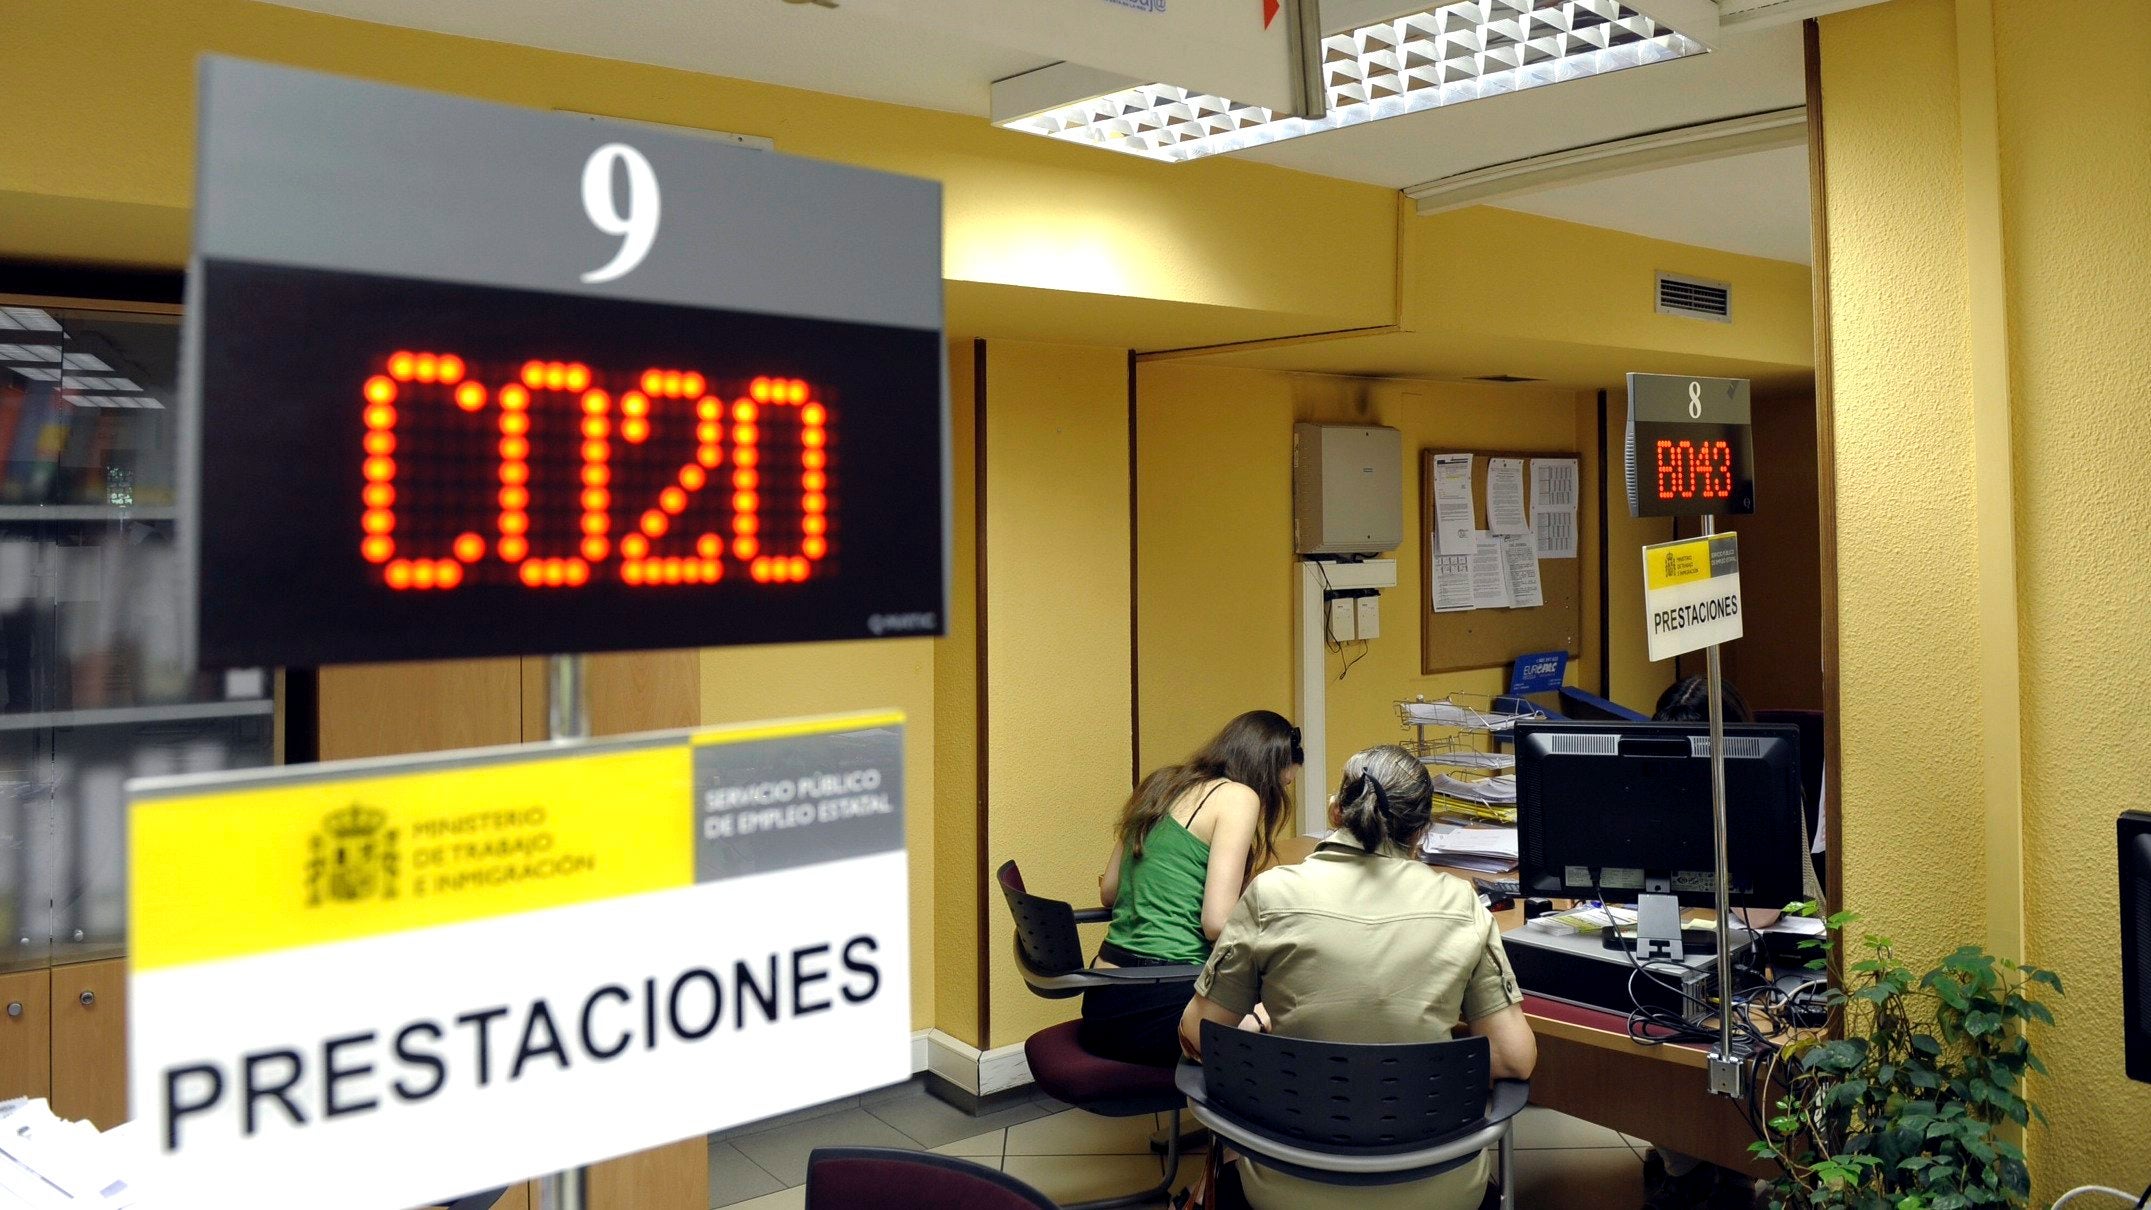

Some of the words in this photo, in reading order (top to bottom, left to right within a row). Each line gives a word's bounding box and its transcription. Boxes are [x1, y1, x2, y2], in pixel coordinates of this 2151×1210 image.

[580, 142, 662, 283] 9
[1688, 381, 1702, 419] 8
[361, 350, 828, 590] C020
[1654, 594, 1738, 635] PRESTACIONES
[704, 779, 796, 813] SERVICIO
[797, 768, 881, 799] PÚBLICO
[412, 805, 546, 838] MINISTERIO
[704, 813, 735, 839] DE
[737, 802, 816, 835] EMPLEO
[817, 791, 894, 823] ESTATAL
[412, 846, 444, 870] DE
[452, 832, 554, 861] TRABAJO
[412, 876, 426, 898] E
[433, 854, 597, 892] INMIGRACIÓN
[162, 934, 882, 1153] PRESTACIONES
